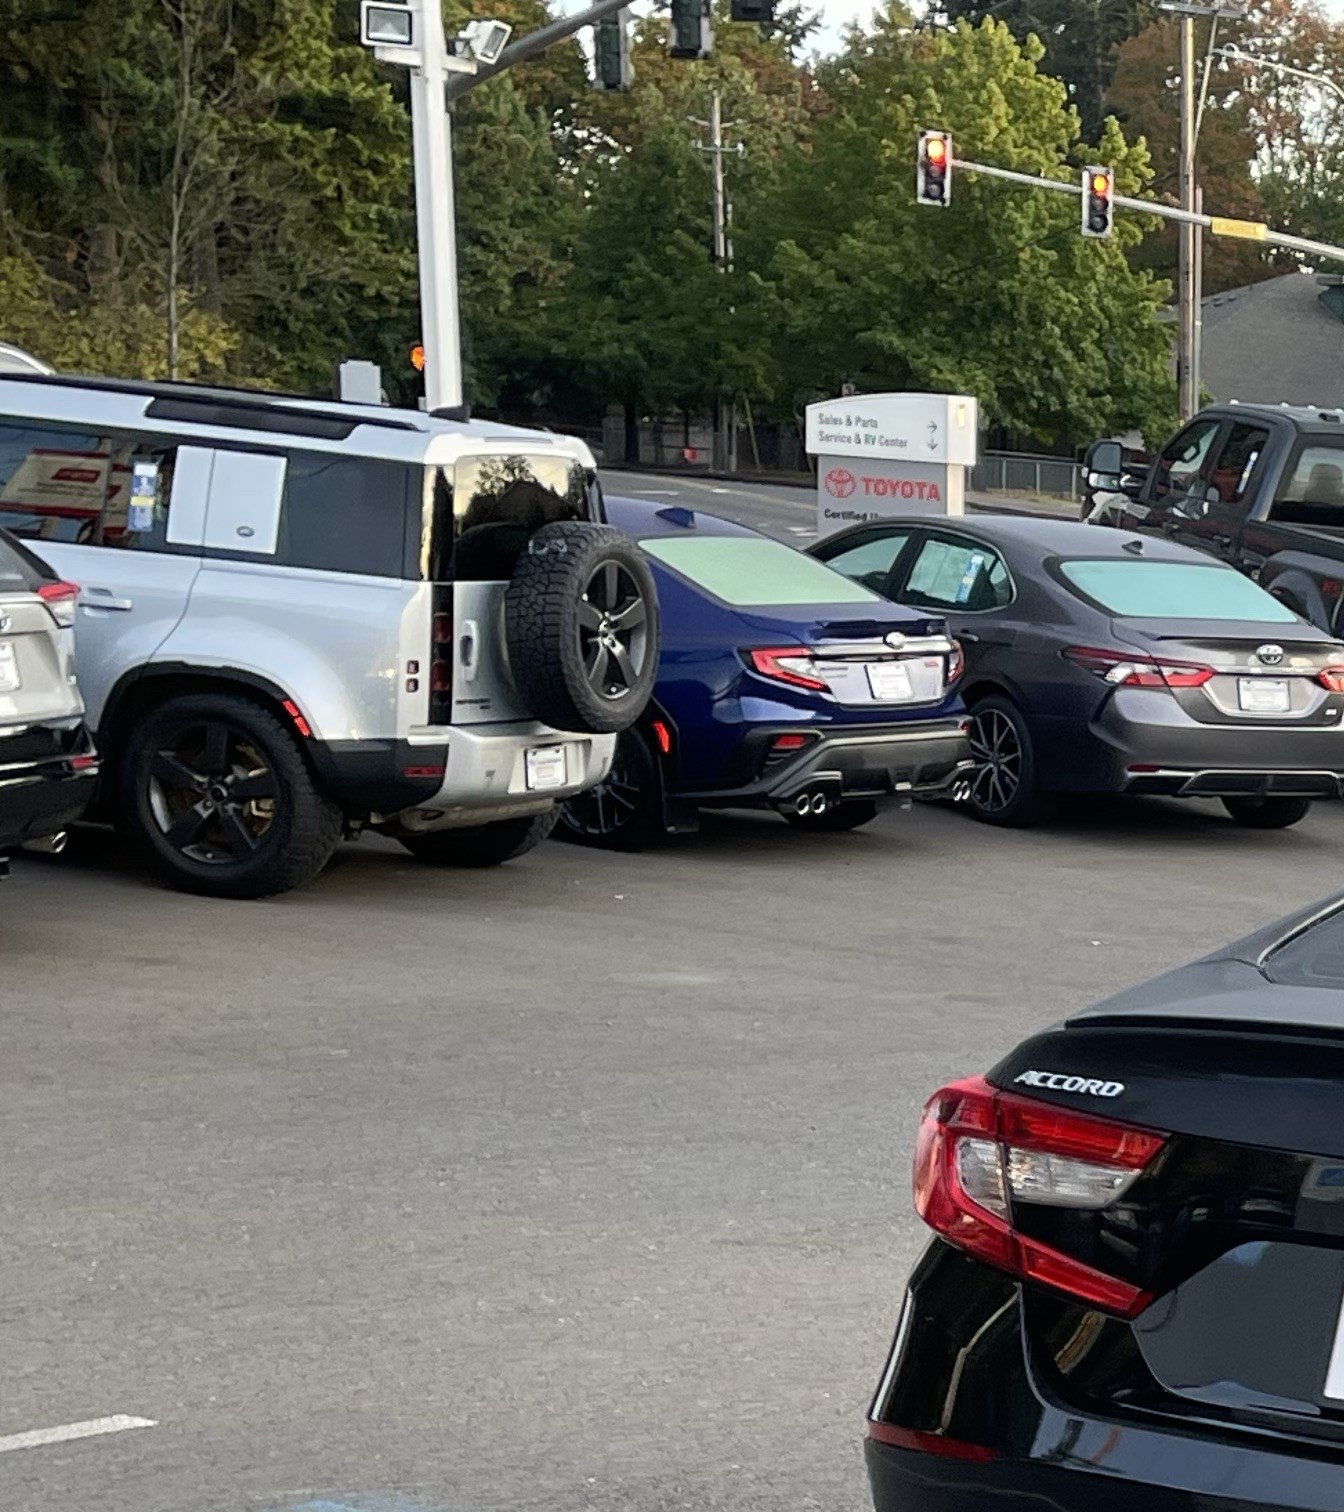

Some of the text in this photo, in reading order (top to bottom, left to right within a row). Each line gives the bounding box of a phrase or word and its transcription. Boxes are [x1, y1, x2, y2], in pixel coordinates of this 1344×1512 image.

[818, 413, 843, 426] Sales
[854, 415, 878, 428] Parts
[818, 430, 852, 444] Service
[864, 434, 877, 446] RV
[878, 436, 908, 448] Center
[862, 477, 940, 501] TOYOTA
[1013, 1070, 1125, 1097] ACCORD
